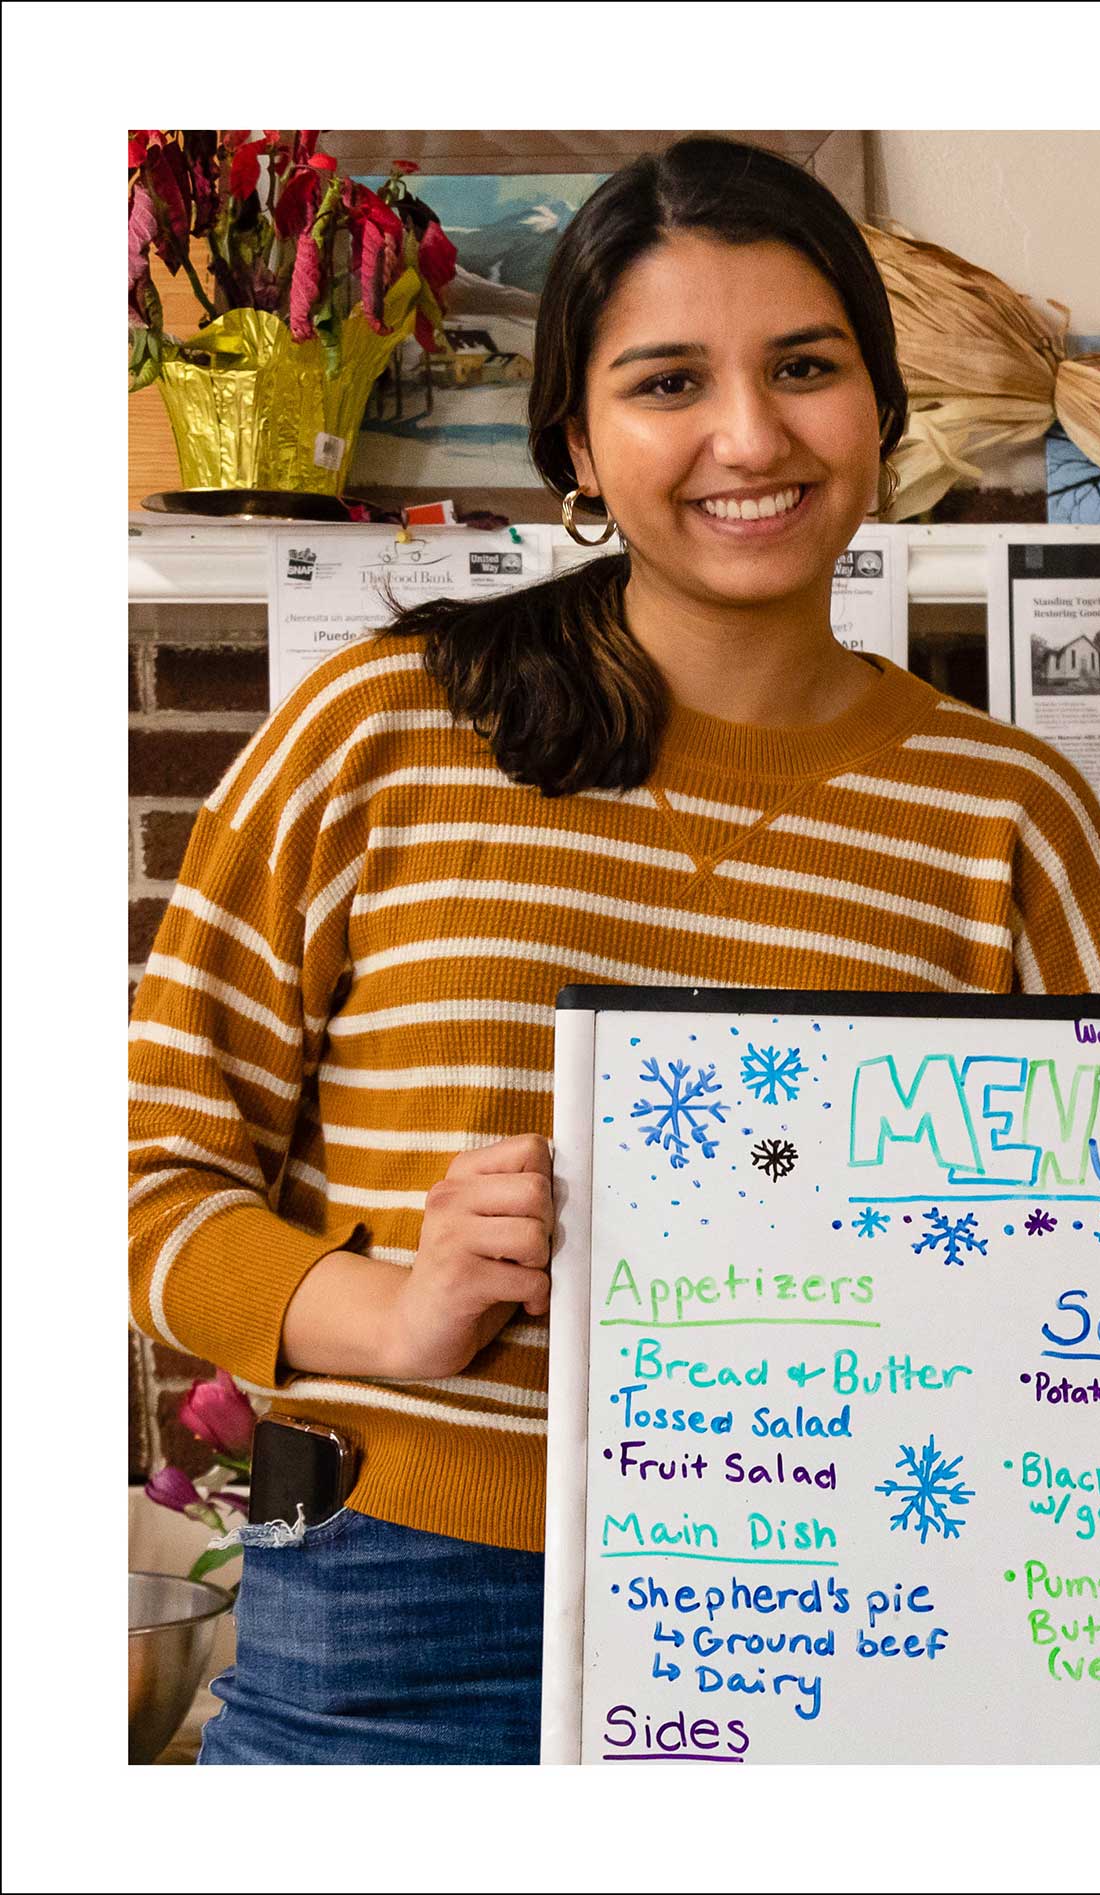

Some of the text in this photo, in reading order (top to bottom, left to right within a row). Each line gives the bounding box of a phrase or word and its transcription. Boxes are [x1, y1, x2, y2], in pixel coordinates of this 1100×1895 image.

[288, 564, 314, 576] SNAP
[420, 571, 454, 584] Bank
[471, 553, 500, 564] United
[481, 563, 499, 575] Way
[1033, 596, 1073, 606] Standing
[1034, 608, 1078, 619] Restoring
[603, 1257, 874, 1322] Appetizers
[633, 1337, 769, 1389] Bread
[832, 1348, 974, 1396] Butter
[619, 1382, 854, 1440] Tossed Salad
[619, 1440, 838, 1491] Fruit Salad
[1028, 1492, 1072, 1525] w/
[602, 1511, 838, 1551] Main Dish
[626, 1575, 937, 1630] Shepherd's pie
[692, 1625, 950, 1661] Ground beef
[694, 1665, 823, 1722] Dairy
[603, 1703, 751, 1755] Sides
